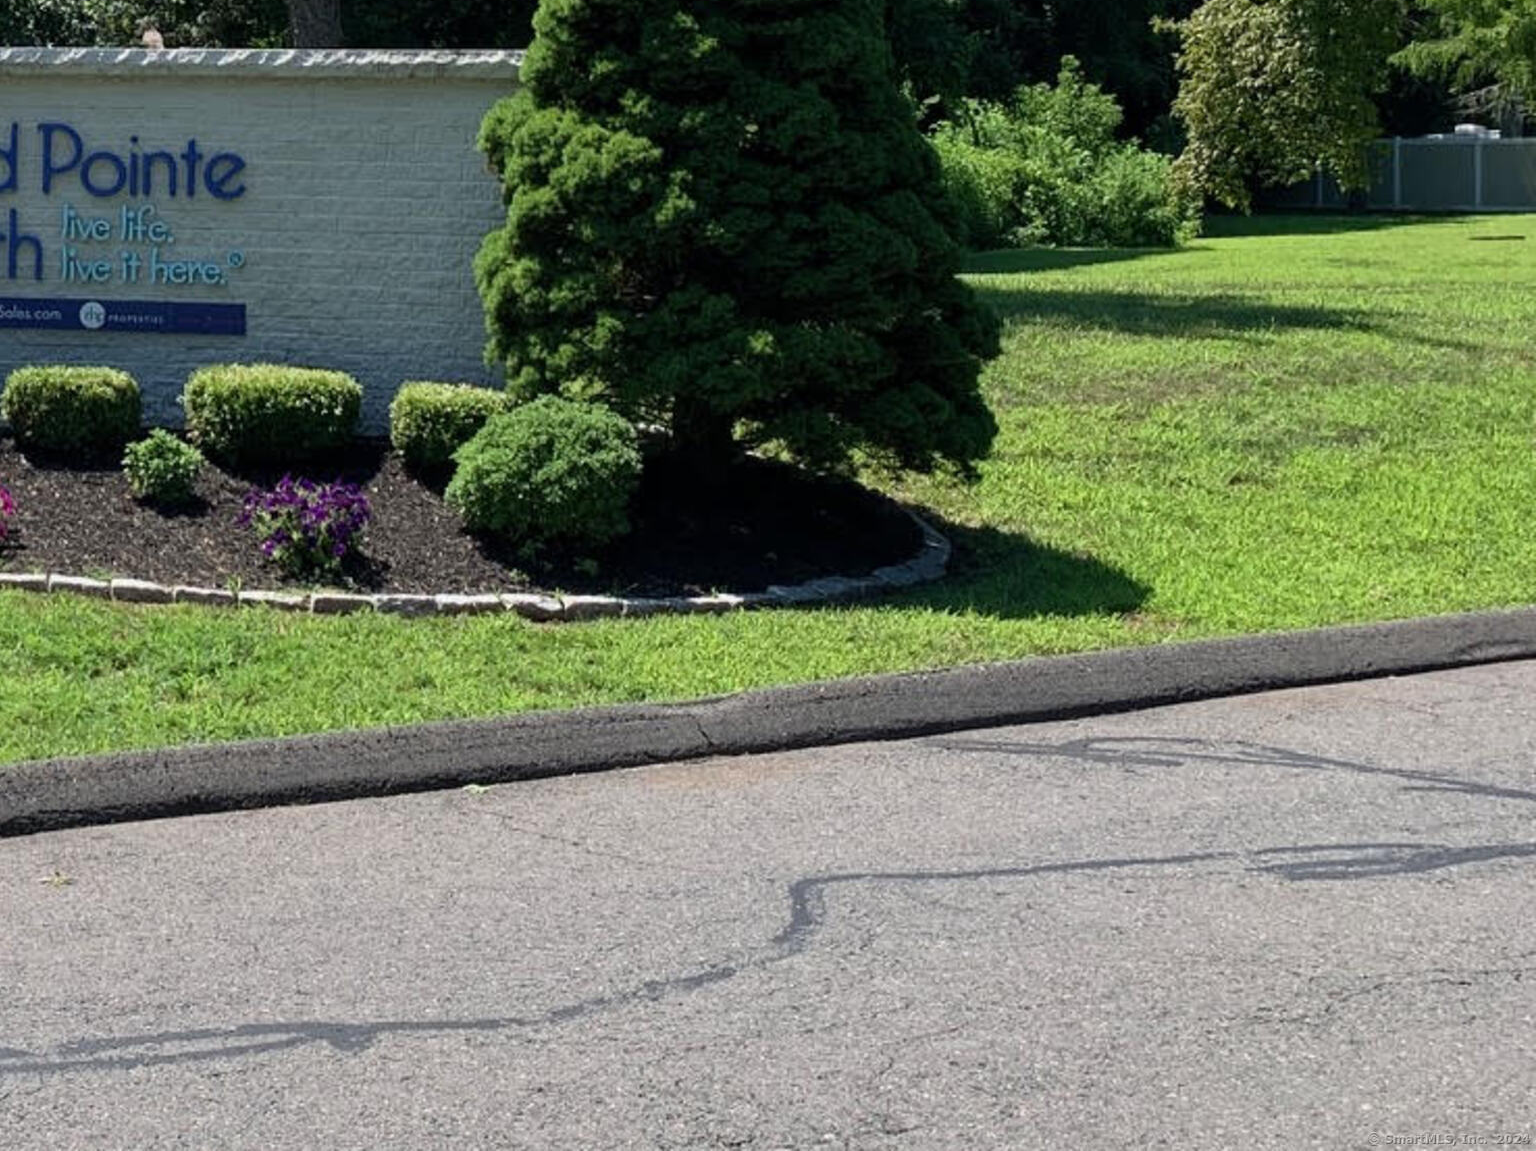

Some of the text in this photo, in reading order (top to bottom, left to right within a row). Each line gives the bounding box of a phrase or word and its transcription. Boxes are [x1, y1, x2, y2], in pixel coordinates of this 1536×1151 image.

[37, 122, 247, 200] Pointe
[62, 203, 175, 243] live life.
[61, 244, 112, 282] live
[122, 251, 141, 282] it
